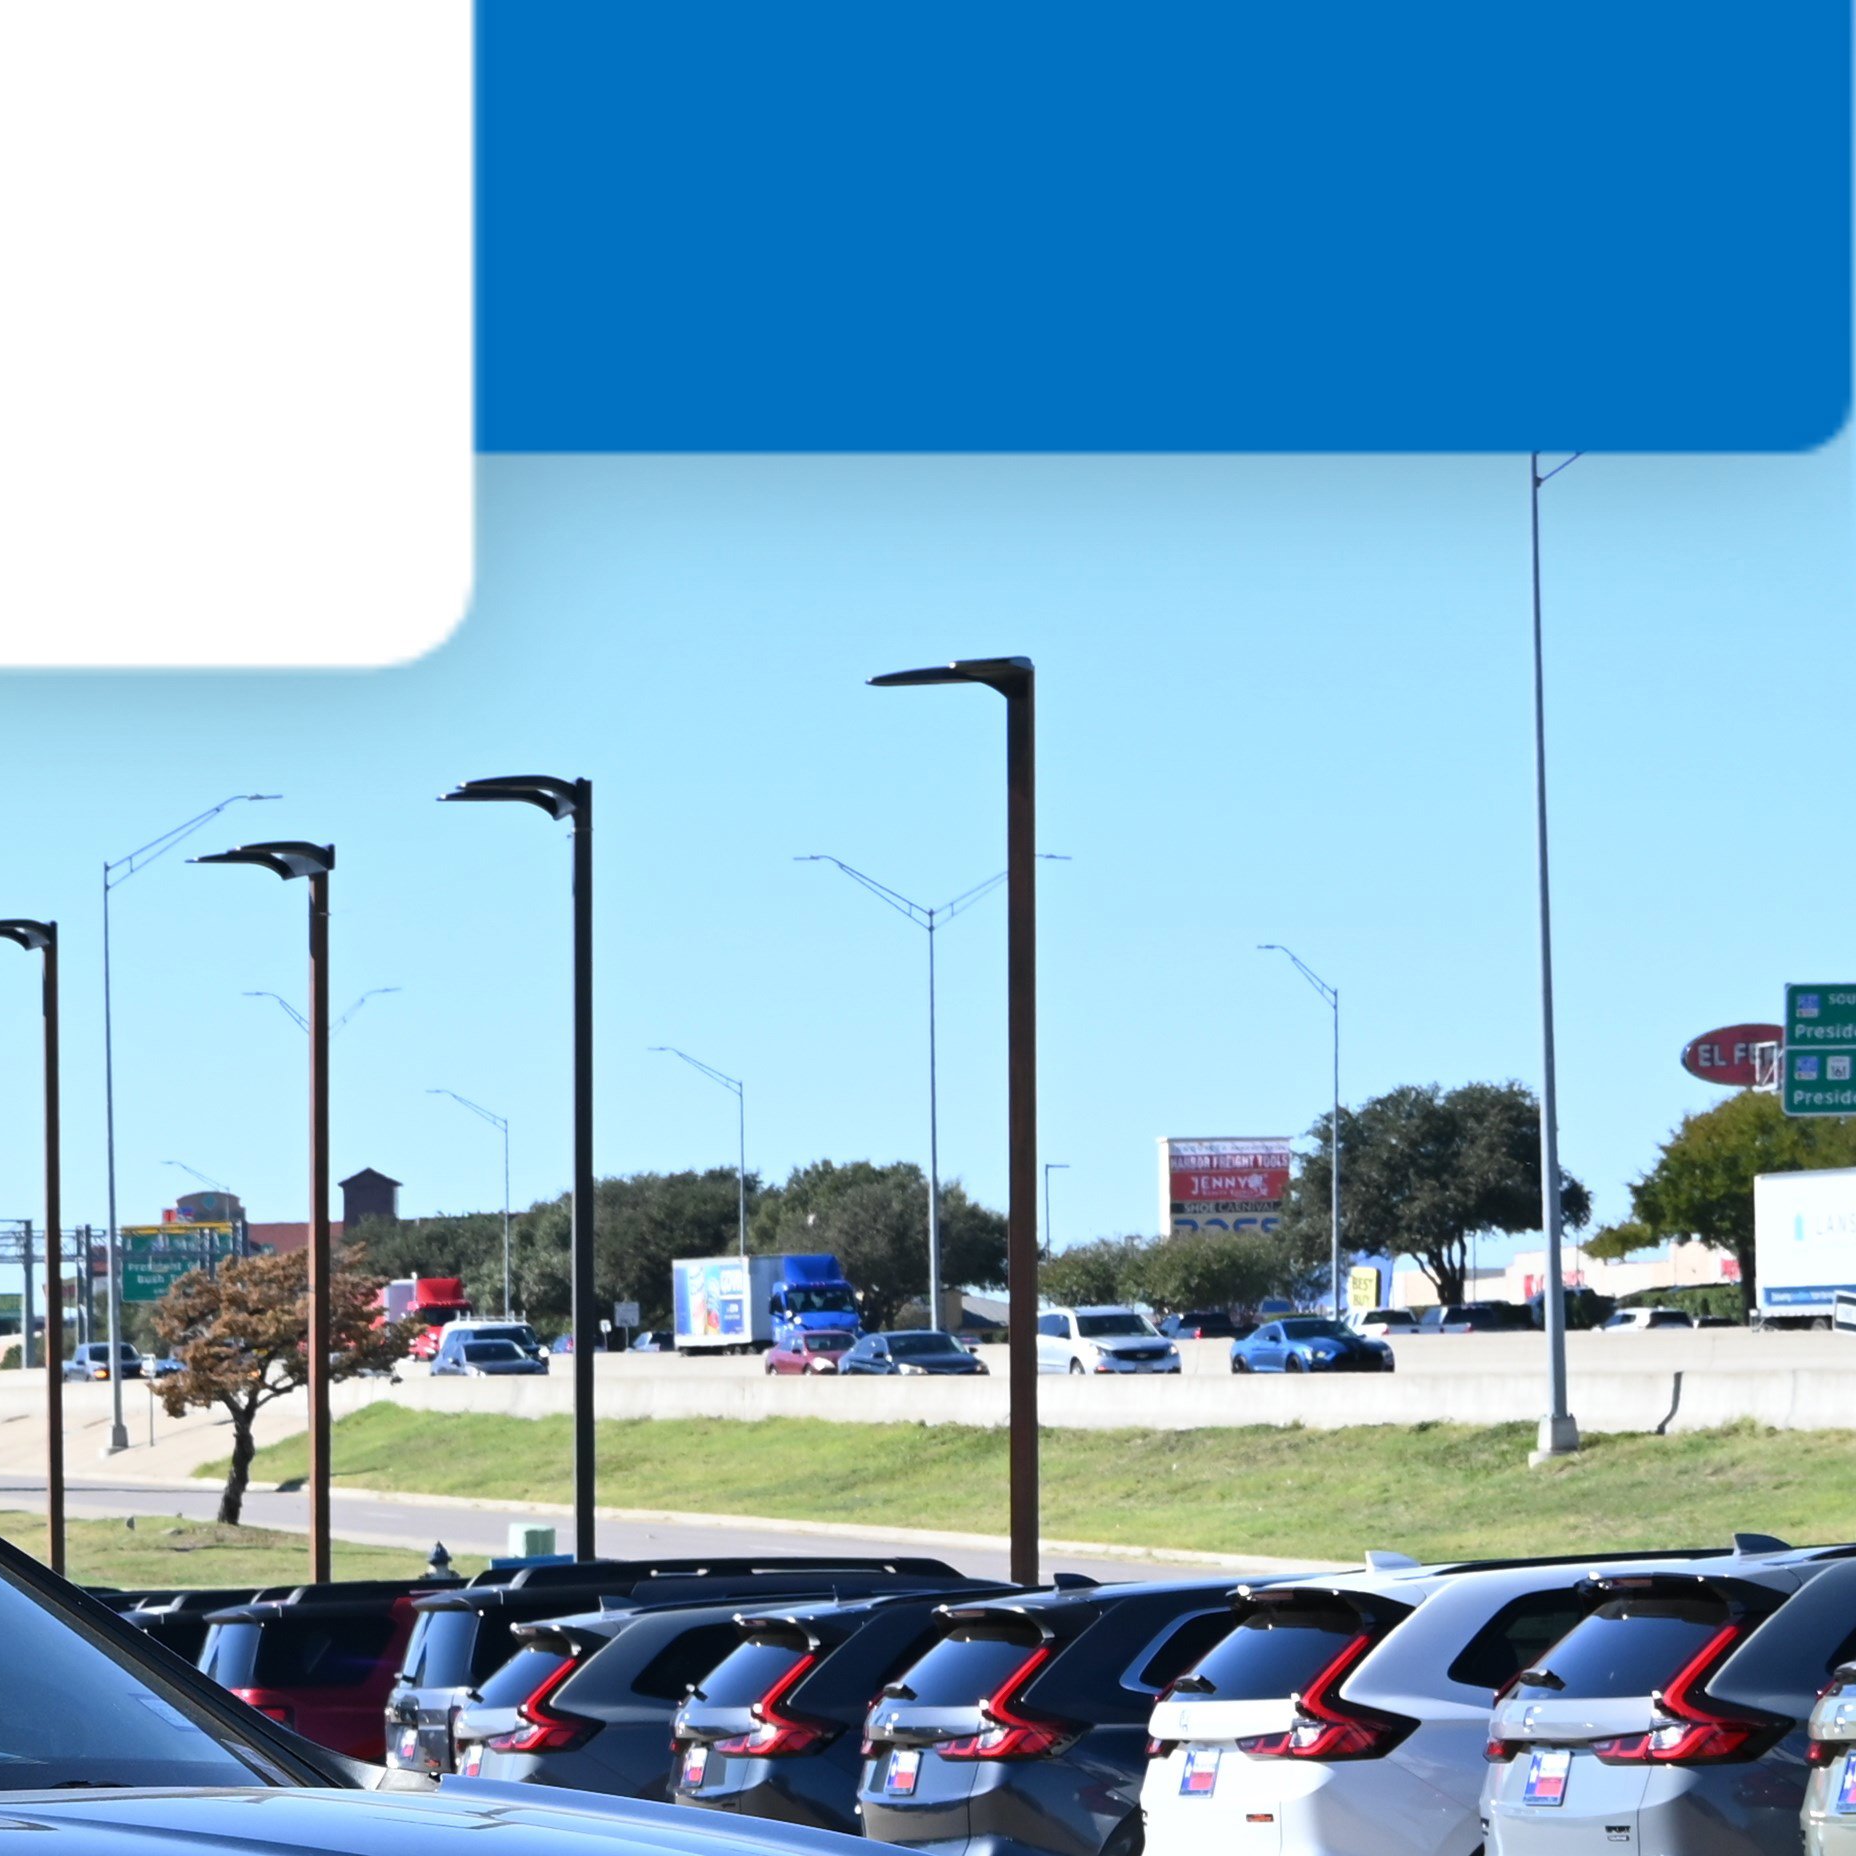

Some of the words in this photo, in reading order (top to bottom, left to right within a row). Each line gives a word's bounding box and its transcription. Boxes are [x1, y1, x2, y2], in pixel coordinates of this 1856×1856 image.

[1795, 1024, 1856, 1039] Presid
[1698, 1044, 1727, 1067] EL
[1191, 1175, 1248, 1196] JENNY
